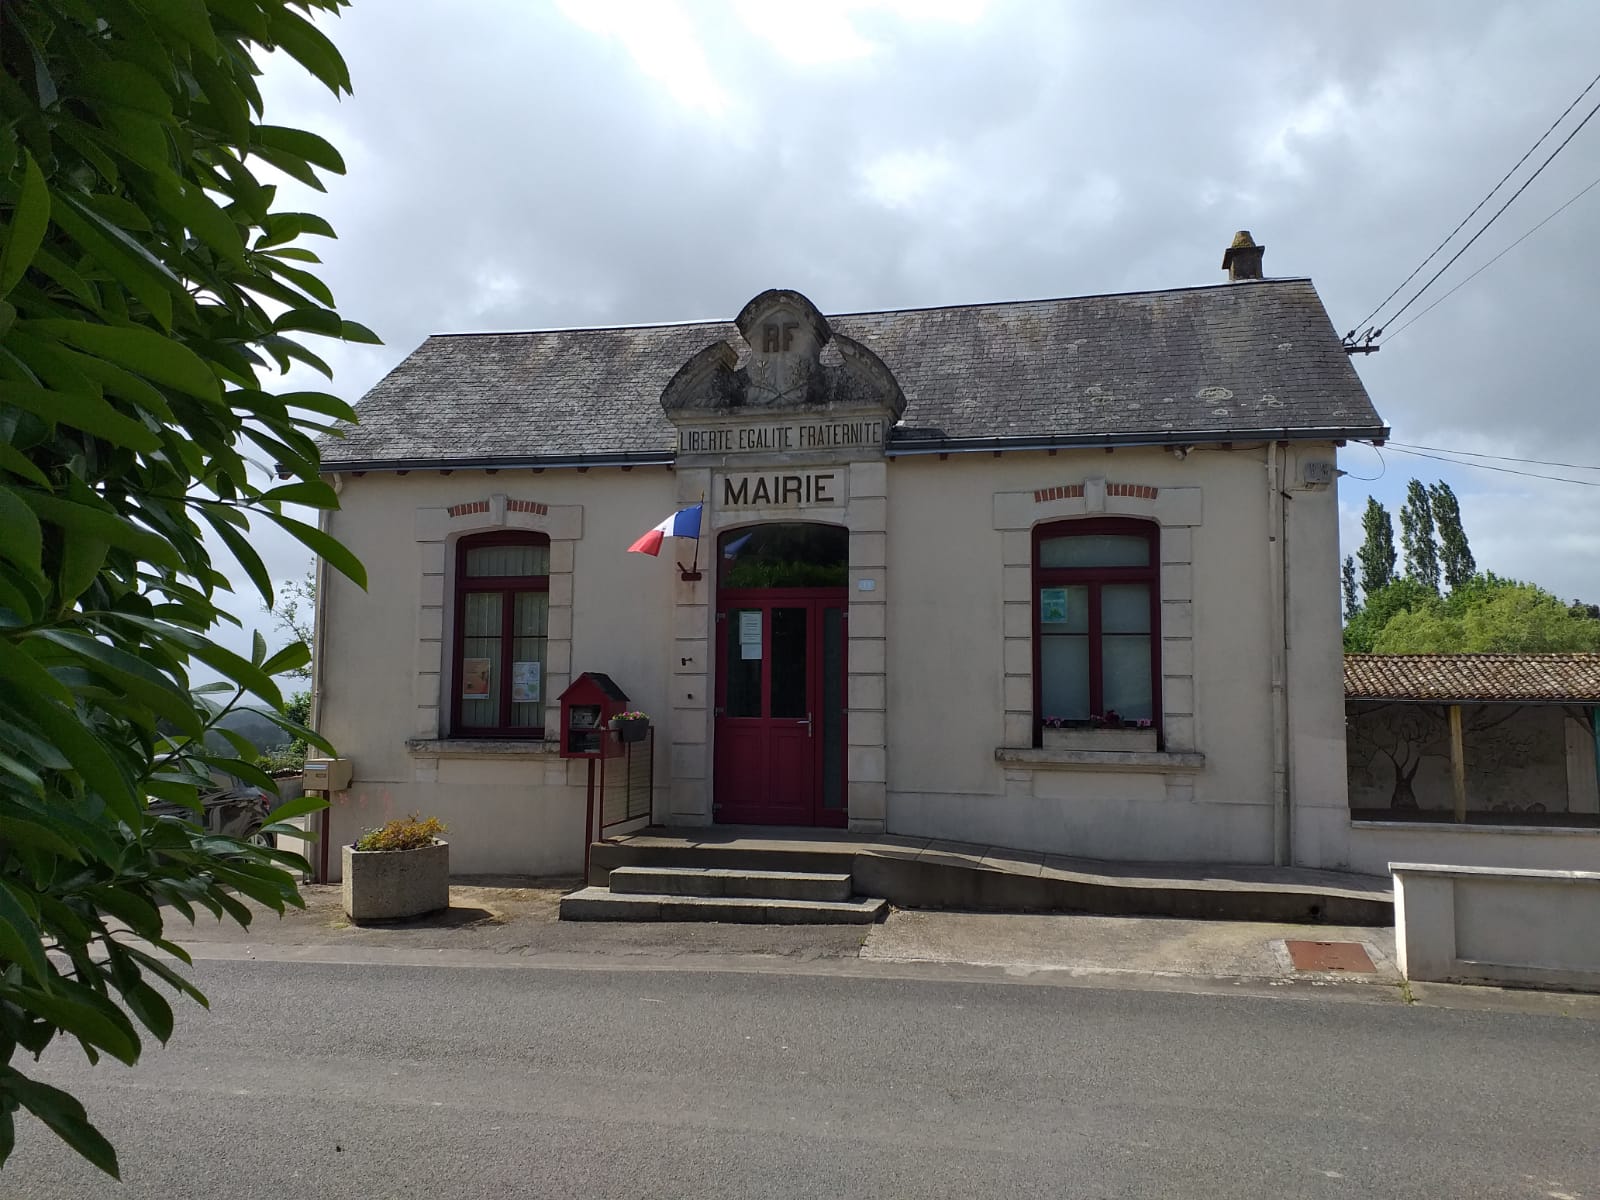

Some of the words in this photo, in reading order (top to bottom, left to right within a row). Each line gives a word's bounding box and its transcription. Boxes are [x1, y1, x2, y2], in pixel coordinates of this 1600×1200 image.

[763, 322, 799, 352] RF
[680, 430, 733, 451] LIBERTE
[739, 427, 793, 449] EGALITE
[800, 422, 881, 446] FRATERNITE
[724, 474, 835, 505] MAIRIE
